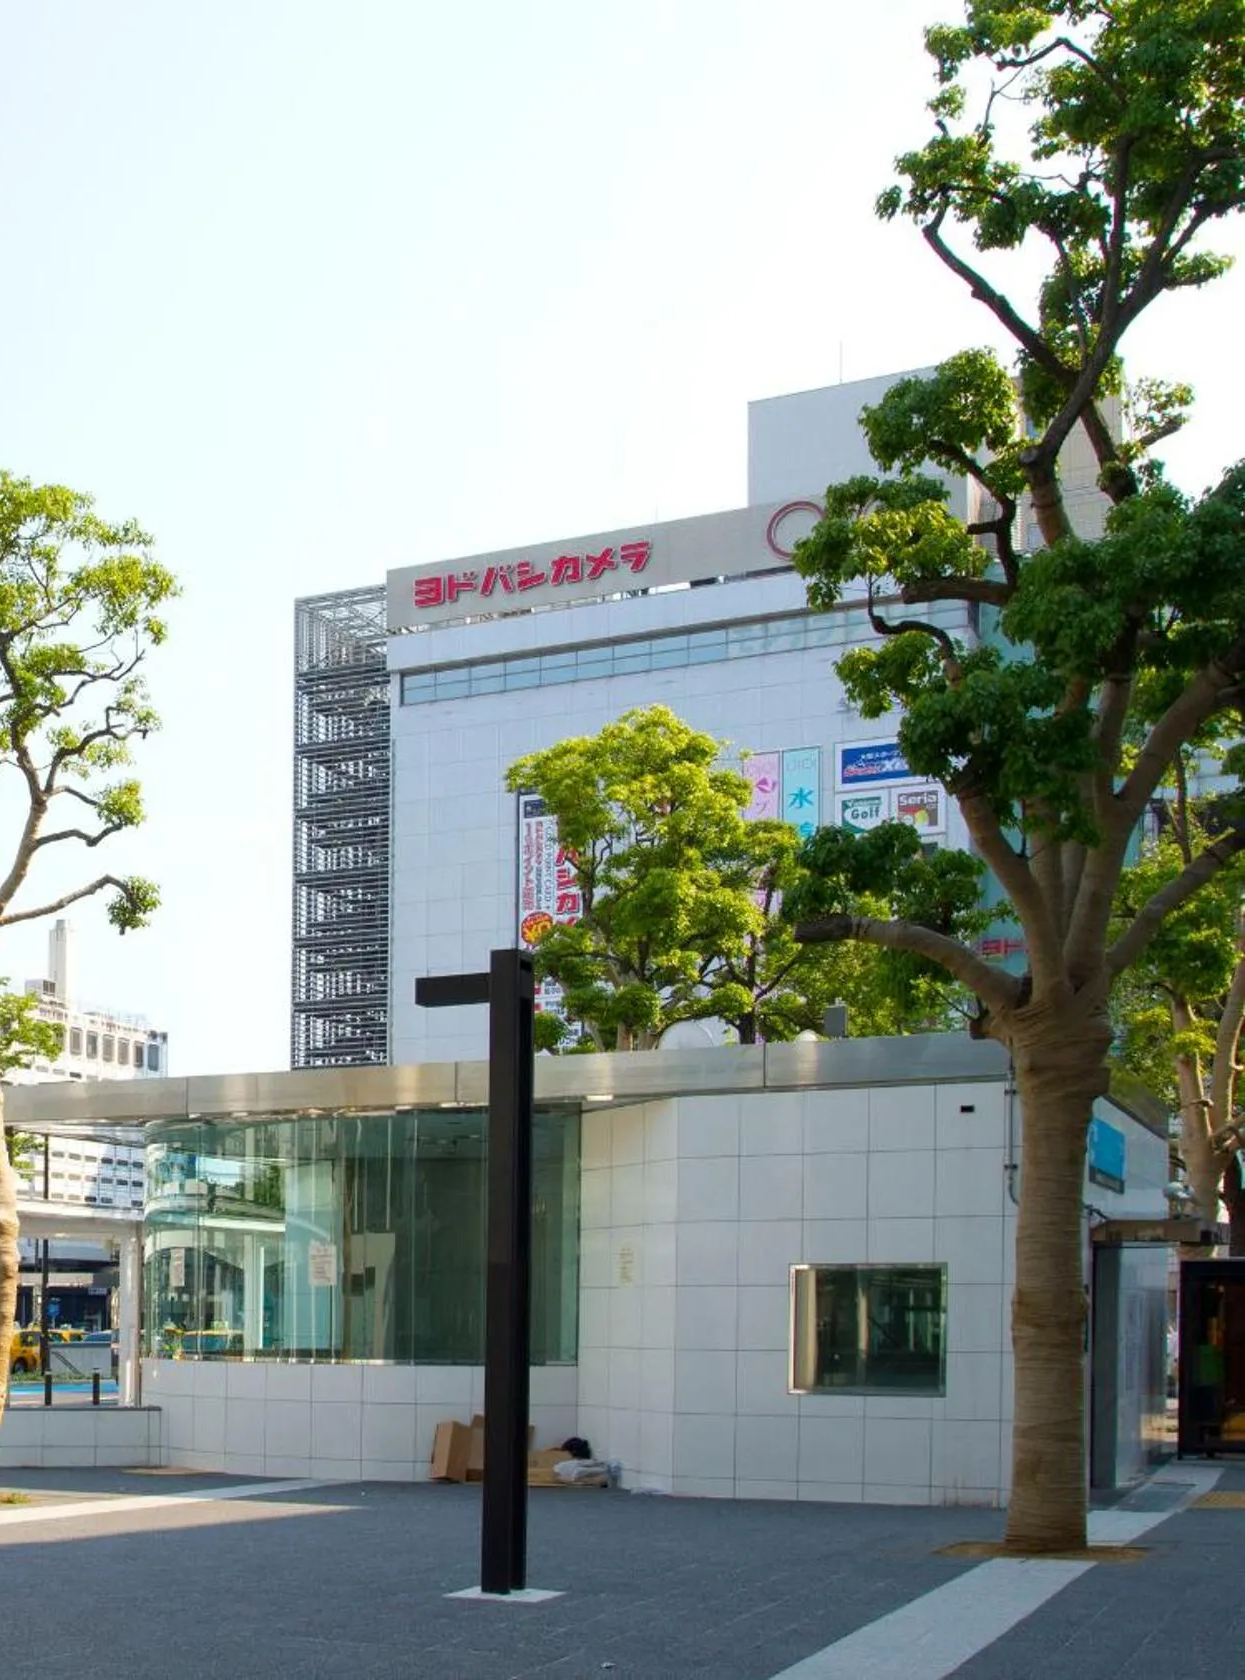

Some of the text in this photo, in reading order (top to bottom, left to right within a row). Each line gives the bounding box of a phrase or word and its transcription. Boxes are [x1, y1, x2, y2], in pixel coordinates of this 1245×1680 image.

[413, 540, 652, 608] ヨドバシカメラ
[899, 792, 937, 806] Seria
[851, 806, 880, 820] Golf
